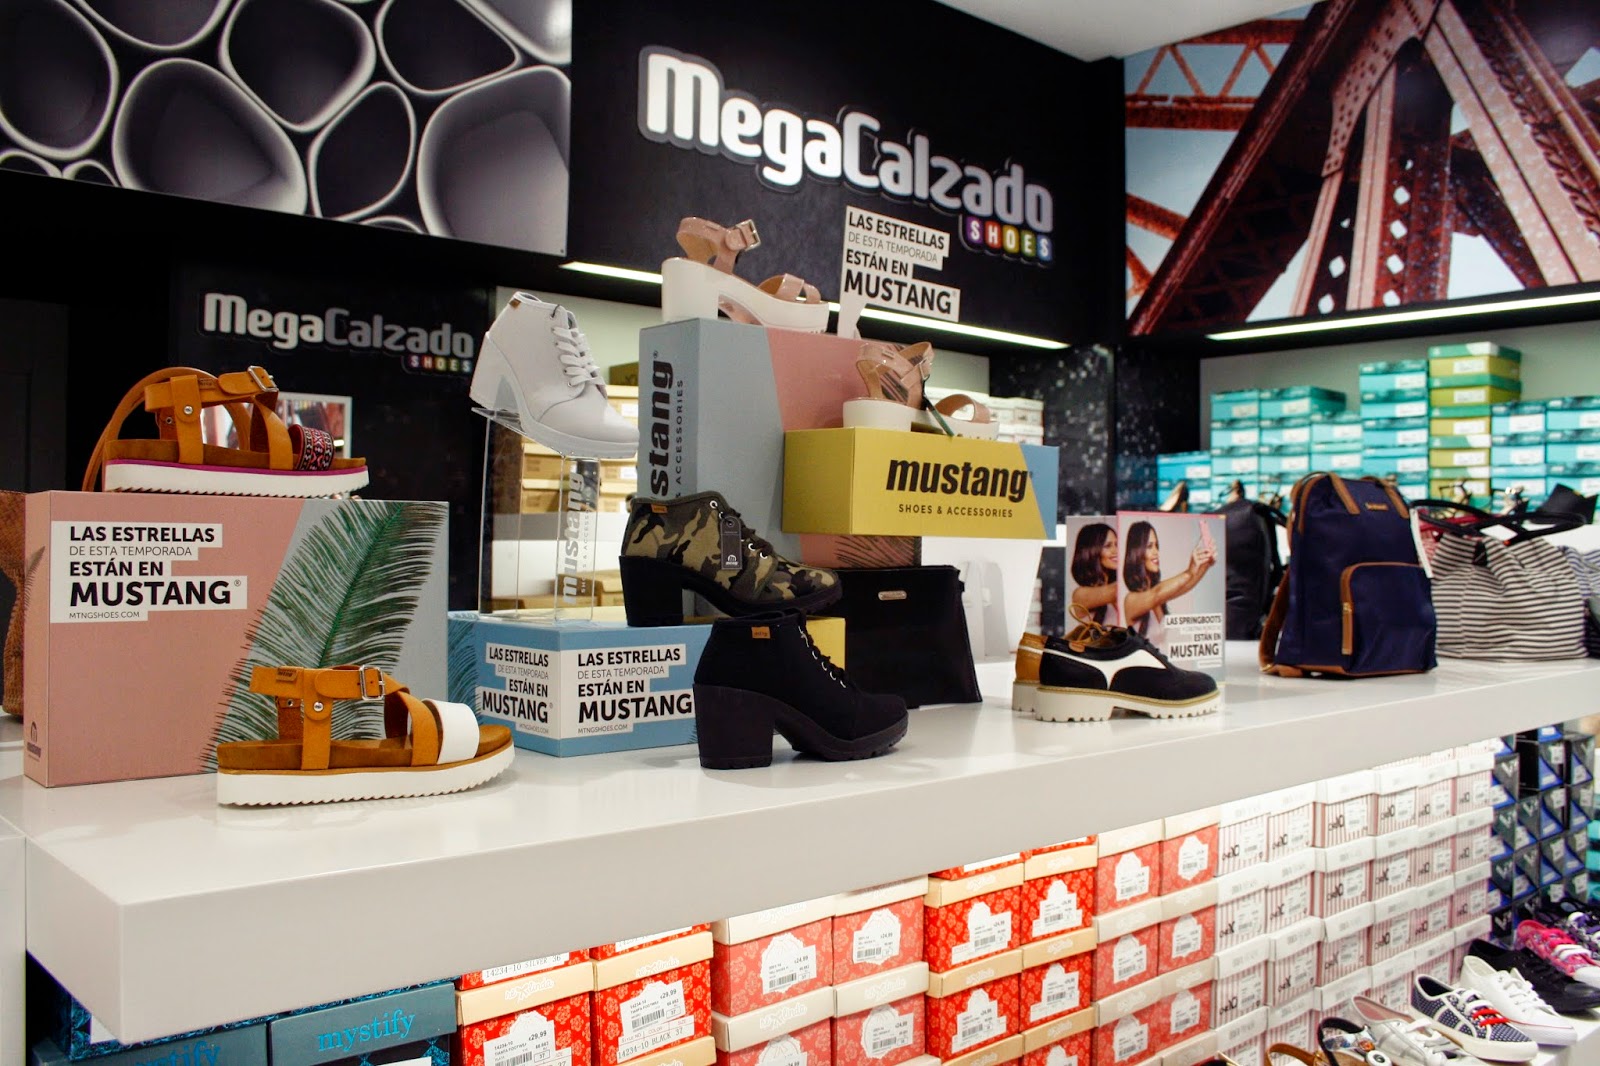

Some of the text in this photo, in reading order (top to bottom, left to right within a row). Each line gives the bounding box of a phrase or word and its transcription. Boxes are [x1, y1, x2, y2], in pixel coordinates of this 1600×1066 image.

[647, 53, 1053, 232] MegaCalzado
[849, 211, 945, 250] LAS ESTRELLAS
[968, 218, 1053, 261] SHOES
[848, 231, 938, 263] DE ESTA TEMPORADA
[846, 248, 908, 277] ESTÁN EN
[844, 269, 951, 315] MUSTANG
[203, 293, 473, 358] MegaCalzado
[411, 355, 471, 374] SHOES
[649, 360, 674, 497] stang
[675, 380, 683, 485] ACCESSORIES
[886, 459, 1028, 503] mustang
[898, 503, 1013, 518] SHOES & ACCESSORIES
[70, 526, 215, 543] LAS ESTRELLAS
[69, 546, 192, 556] DE ESTA TEMPORADA
[70, 558, 163, 576] ESTÁN EN
[69, 611, 140, 619] MTNGSHOES.COM
[489, 646, 549, 667] LAS ESTRELLAS
[578, 648, 680, 667] LAS ESTRELLAS
[1170, 643, 1219, 658] MUSTANG
[497, 664, 549, 680] DE ESTA TEMPORADA
[578, 665, 665, 679] DE ESTA TEMPORADA
[509, 678, 548, 698] ESTÁN EN
[578, 679, 644, 697] ESTÁN EN
[482, 691, 548, 723] MUSTANG
[578, 693, 693, 724] MUSTANG
[578, 724, 628, 734] MTNGSHOES.COM
[486, 965, 521, 978] 14234-10
[318, 1009, 415, 1052] mystify
[618, 1028, 683, 1060] 14234-10 BLACK 37
